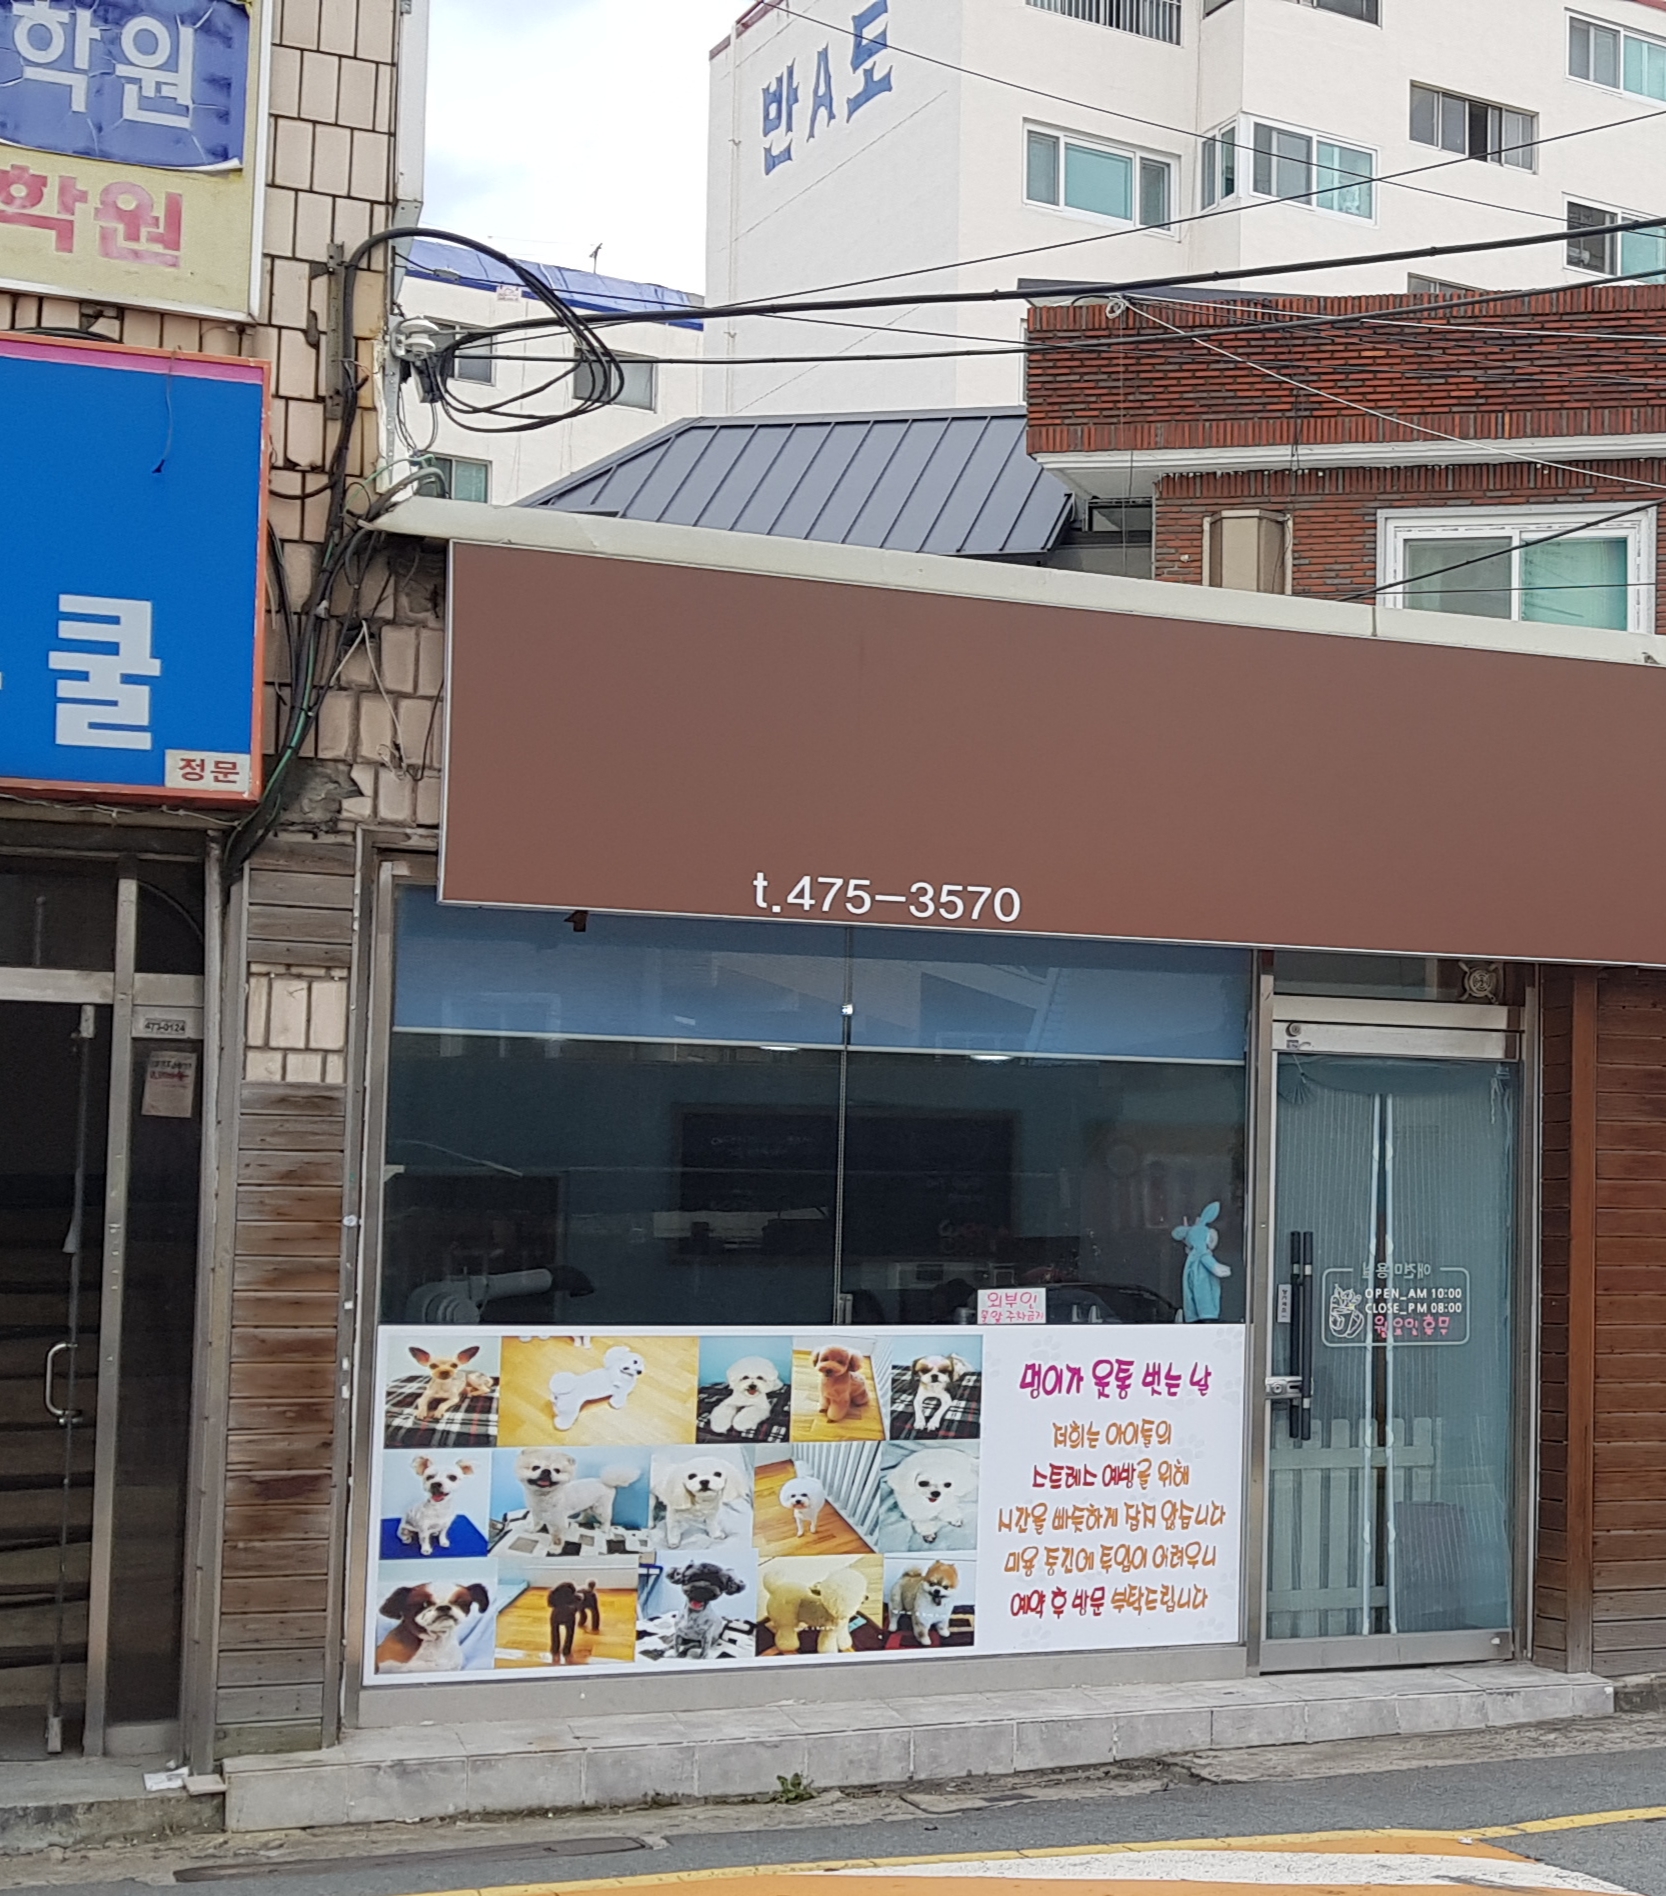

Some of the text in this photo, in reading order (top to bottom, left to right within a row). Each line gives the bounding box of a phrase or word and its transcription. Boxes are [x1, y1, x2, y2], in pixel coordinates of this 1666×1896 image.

[12, 0, 195, 129] 학원
[0, 164, 183, 268] 학원
[48, 593, 162, 750] 쿨
[178, 757, 240, 784] 정문
[987, 1292, 1038, 1309] 외부인
[1430, 1303, 1462, 1313] 08:00
[1431, 1288, 1462, 1299] 10:00
[1019, 1362, 1084, 1400] 멍이가
[1141, 1361, 1182, 1397] 벗는
[1189, 1361, 1212, 1397] 날
[1052, 1418, 1172, 1449] 저희는 아이들의
[1032, 1462, 1098, 1489] 스트레스
[1157, 1459, 1190, 1488] 위해
[998, 1499, 1226, 1535] 시간을 빠듯하게 잡지 않습니다
[1004, 1546, 1039, 1577] 미용
[1099, 1543, 1148, 1574] 투입이
[1152, 1541, 1216, 1570] 어려우니
[1010, 1583, 1209, 1619] 예약 후 방문 부탁드립니다
